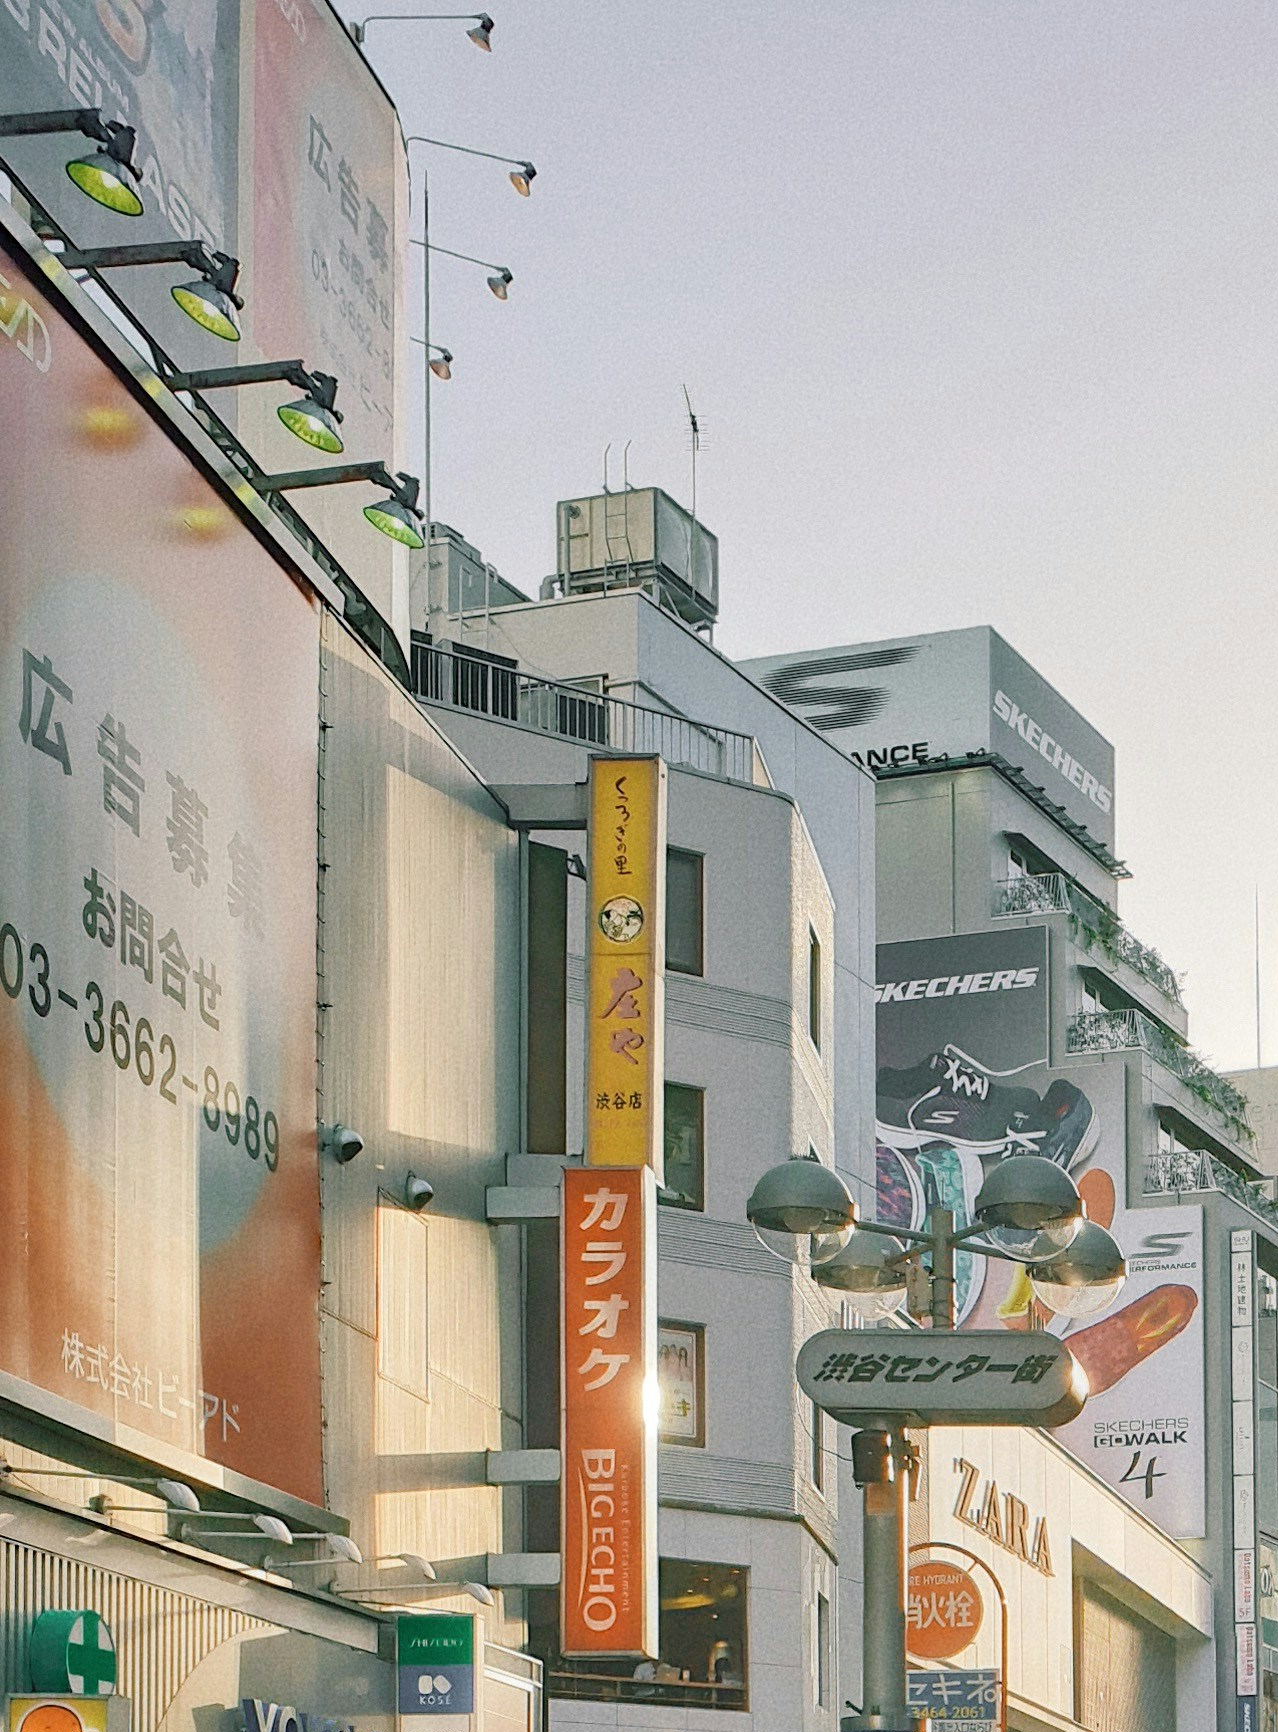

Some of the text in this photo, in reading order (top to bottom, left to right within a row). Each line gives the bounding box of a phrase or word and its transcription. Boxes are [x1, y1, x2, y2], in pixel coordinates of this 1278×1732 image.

[992, 689, 1112, 815] SKECHERS
[82, 866, 222, 1031] お問合せ
[0, 922, 279, 1172] 03-3662-8989
[596, 1092, 643, 1110] 渋谷店
[578, 1187, 631, 1392] カラオケ
[61, 1327, 240, 1442] 株式会社ビーアド
[813, 1353, 1059, 1385] 渋谷センター街
[1094, 1418, 1190, 1431] SKECHERS
[953, 1457, 1056, 1578] ZARA
[1119, 1451, 1168, 1499] 4
[581, 1448, 617, 1632] BIG ECHO
